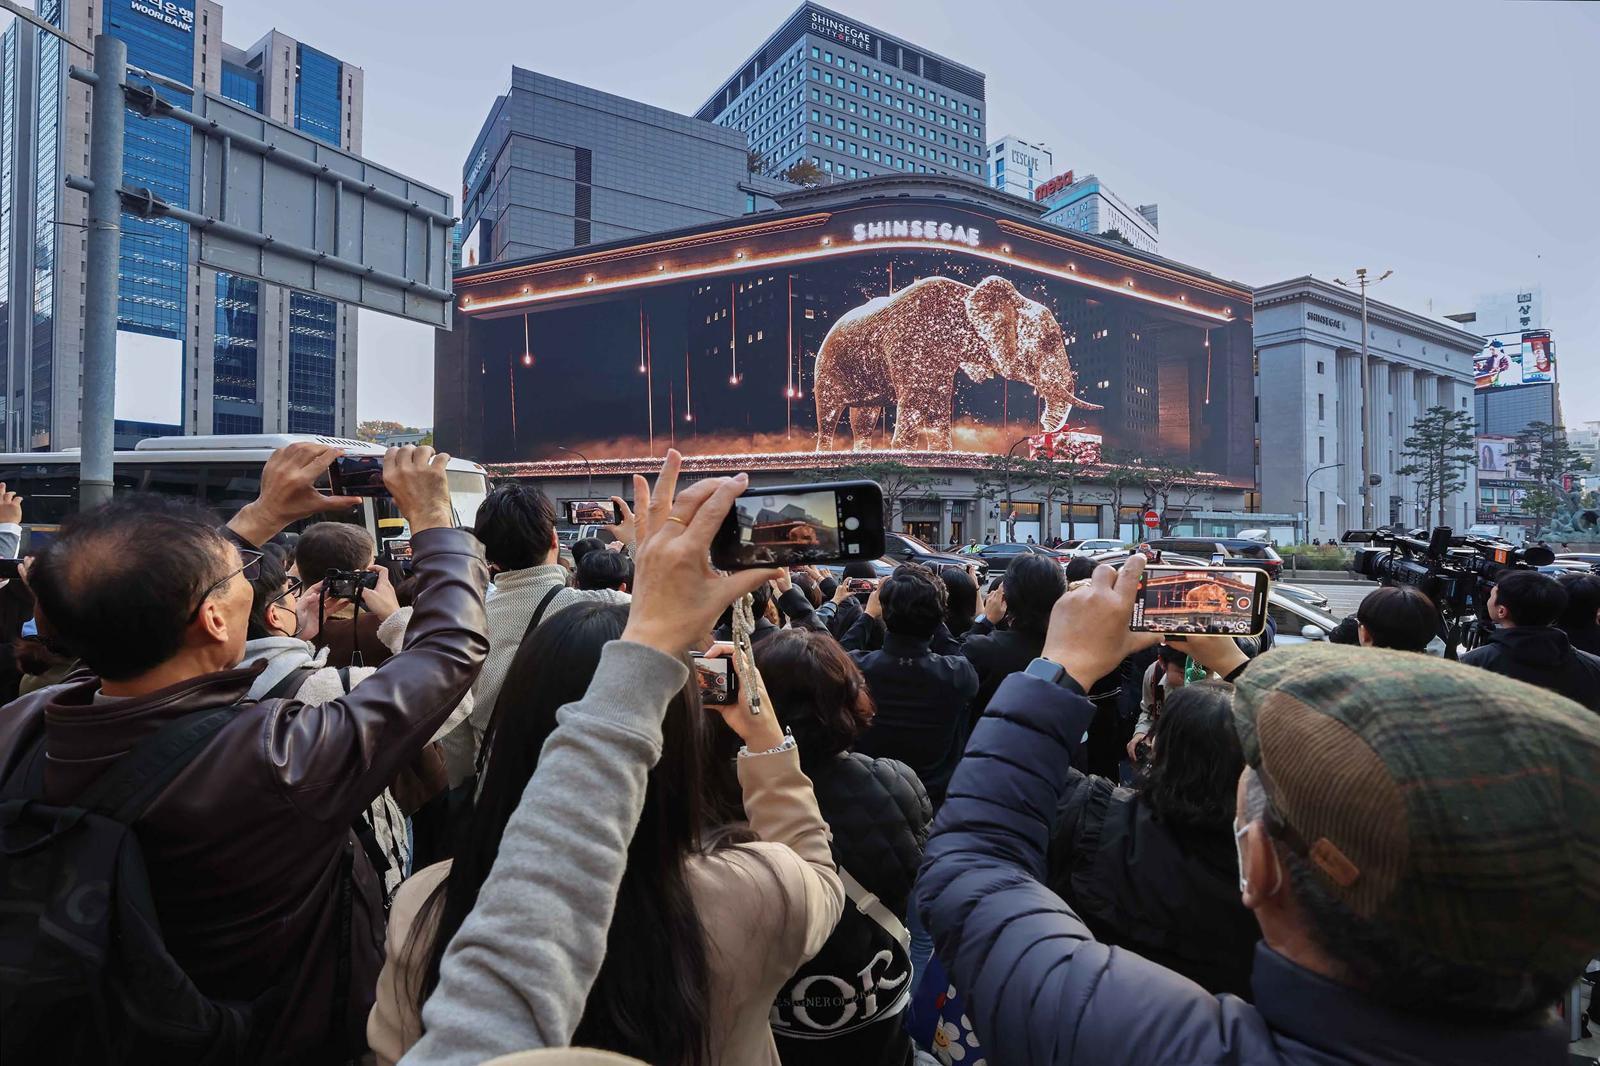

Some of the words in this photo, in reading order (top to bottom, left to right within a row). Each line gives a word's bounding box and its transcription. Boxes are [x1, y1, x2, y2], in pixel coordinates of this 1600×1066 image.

[131, 1, 163, 20] WOORI
[164, 16, 193, 33] BANK
[136, 0, 194, 23] 리은행
[811, 12, 870, 44] SHINSEGAE
[811, 23, 837, 38] DUTY
[845, 36, 871, 52] FREE
[1011, 149, 1039, 172] L'ESCAPE
[1034, 169, 1073, 202] mesa
[853, 220, 980, 247] SHINSEGAE
[1306, 311, 1341, 329] SHINSEGAE
